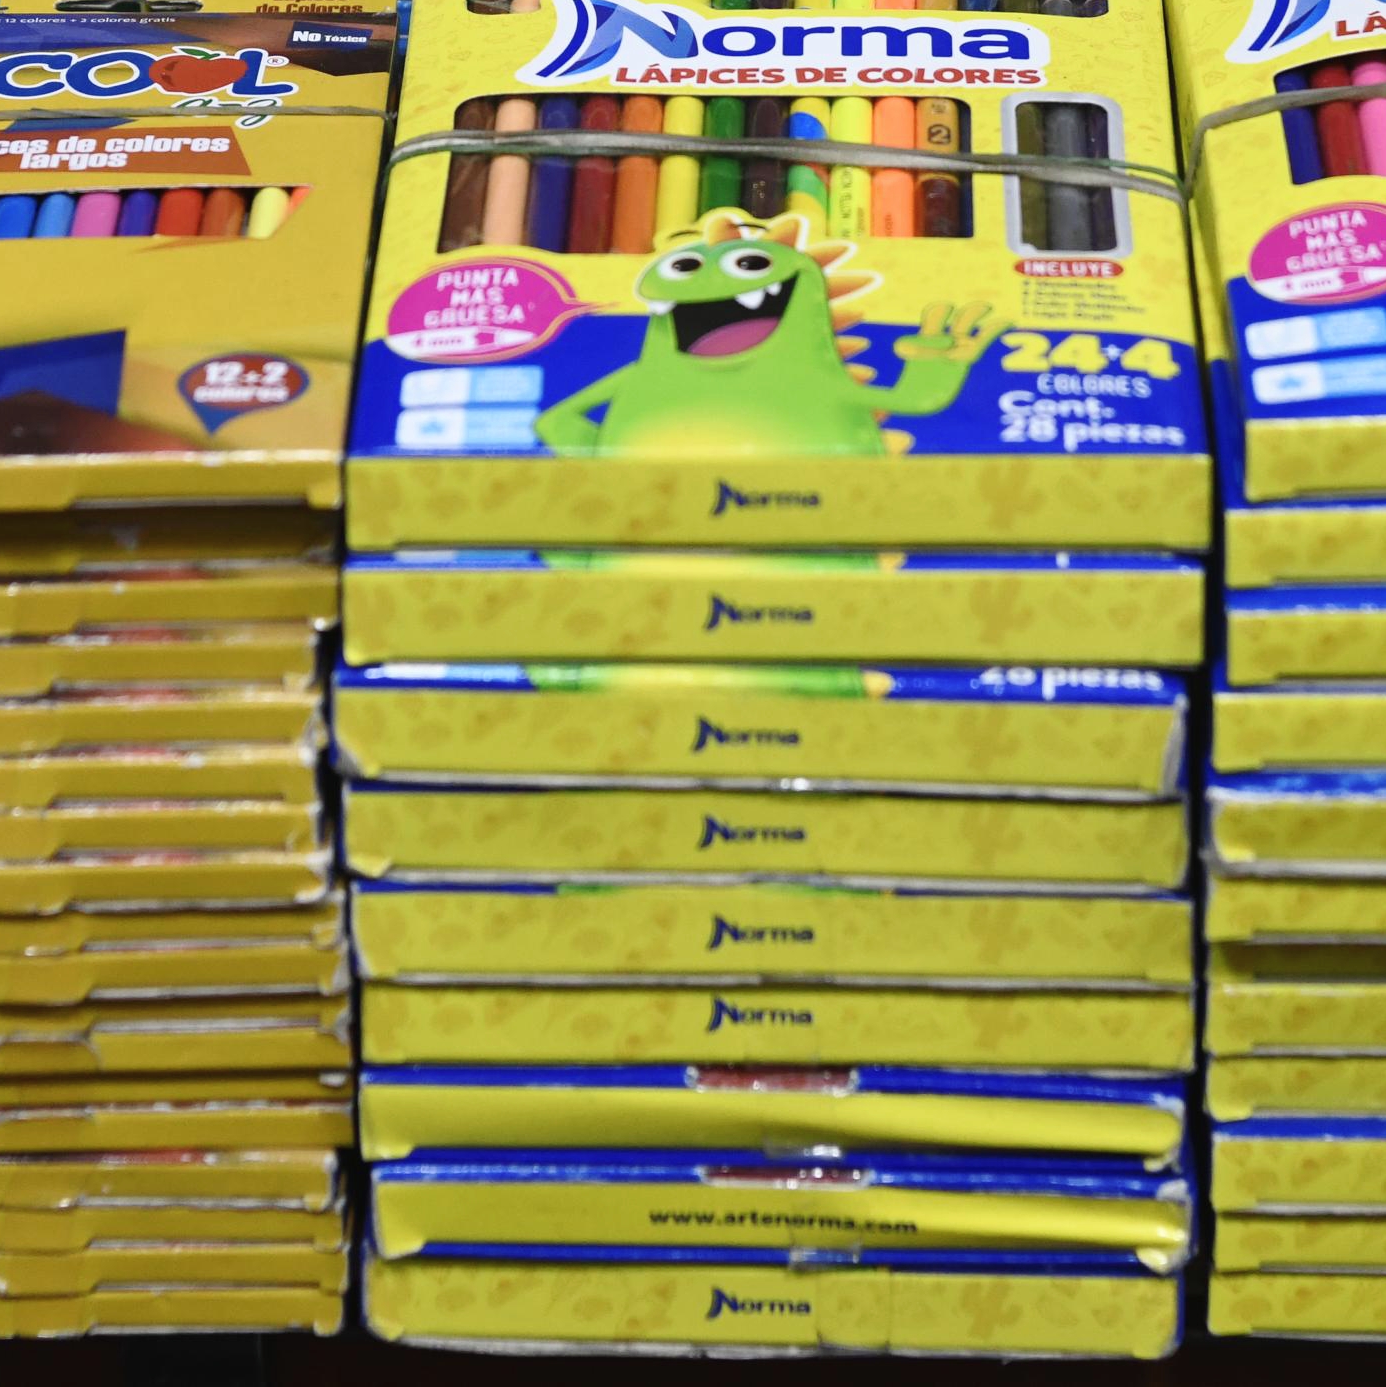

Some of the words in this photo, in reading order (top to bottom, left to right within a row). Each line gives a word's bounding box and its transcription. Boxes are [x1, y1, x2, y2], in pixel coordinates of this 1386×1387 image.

[19, 17, 66, 25] colores
[92, 17, 138, 25] colores
[141, 16, 175, 27] gratis
[293, 30, 321, 44] No
[615, 61, 788, 86] LÁPICES
[794, 66, 848, 85] DE
[855, 66, 1043, 87] COLORES
[59, 136, 101, 154] de
[104, 135, 230, 154] colores
[19, 149, 128, 172] largos
[1288, 210, 1368, 239] PUNTA
[436, 268, 520, 291] PUNTA
[1023, 260, 1114, 278] INCLUYE
[1036, 372, 1153, 399] COLORES
[1063, 417, 1187, 453] piezas
[649, 1208, 919, 1236] www.artenorma.com
